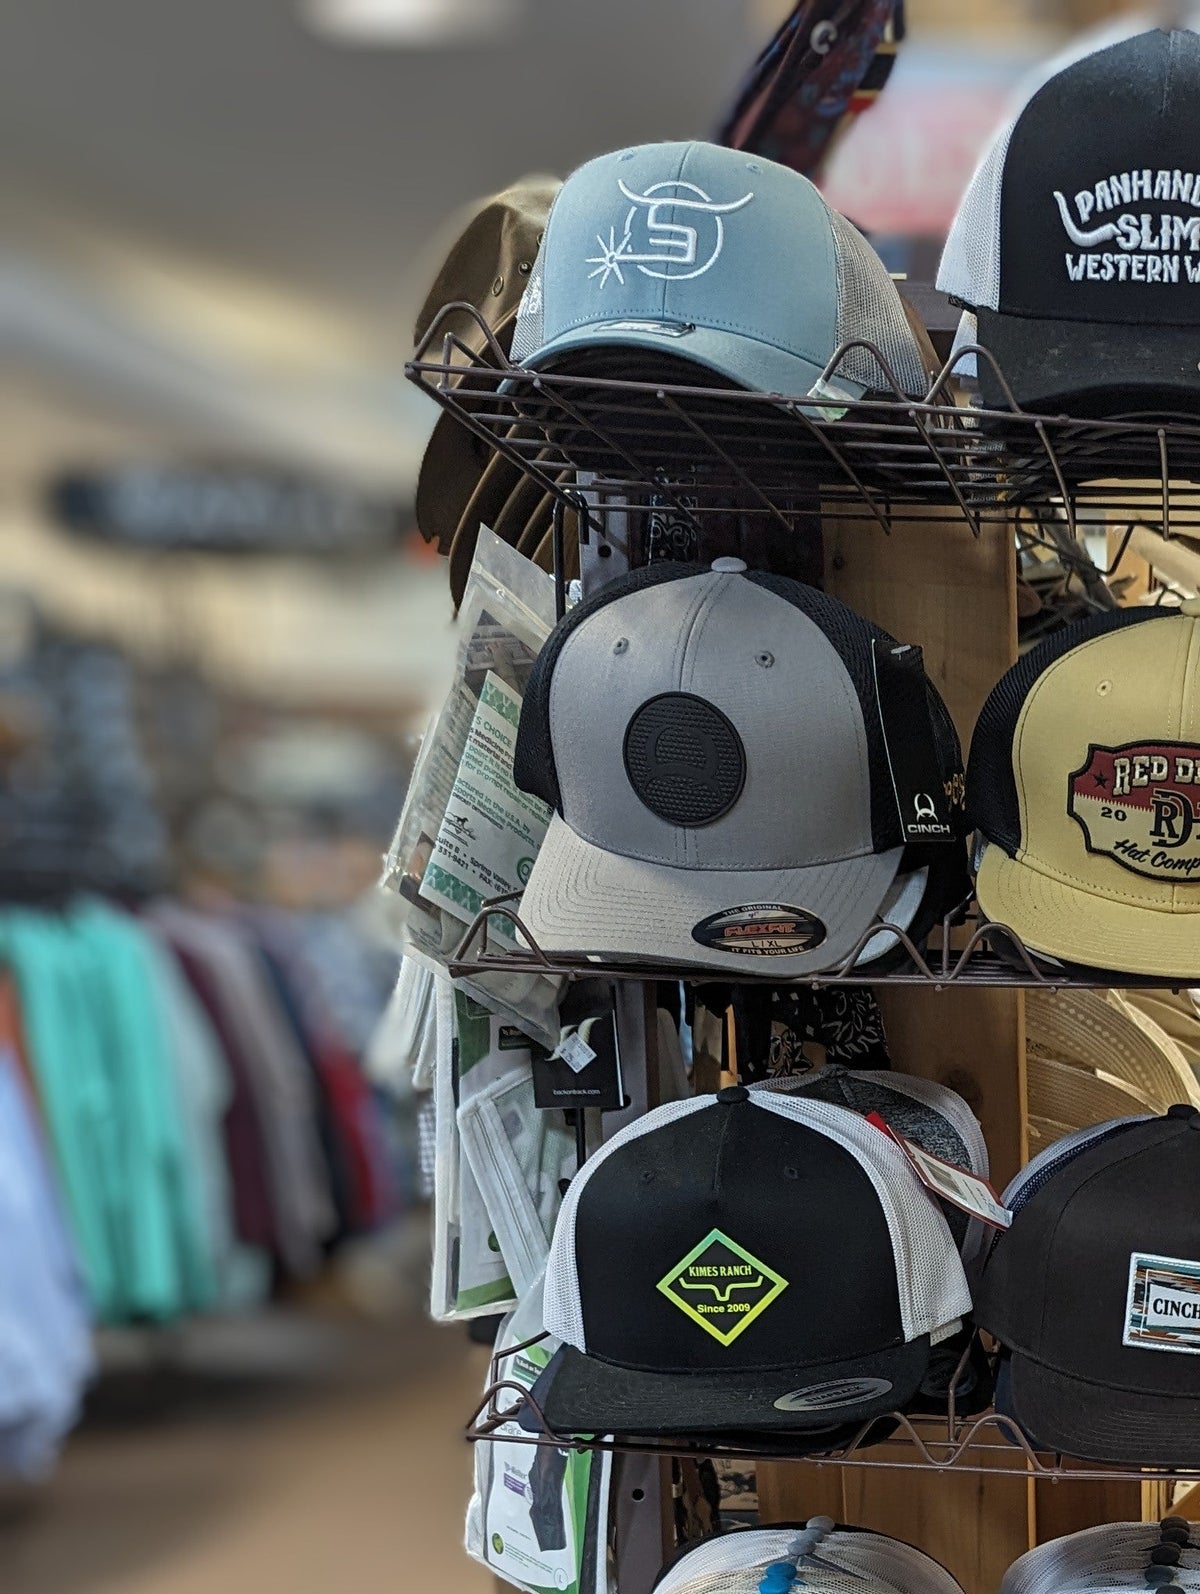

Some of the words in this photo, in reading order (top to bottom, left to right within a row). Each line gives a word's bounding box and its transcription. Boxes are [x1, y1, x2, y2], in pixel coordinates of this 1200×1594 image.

[1065, 253, 1179, 283] WESTERN
[483, 721, 514, 748] CHOICE
[475, 731, 505, 755] Medicine
[1112, 755, 1168, 796] RED
[1101, 807, 1128, 822] 20
[907, 823, 951, 834] CINCH
[1113, 839, 1151, 863] Hat
[741, 903, 783, 913] ORIGINAL
[723, 922, 797, 937] FLEXFIT
[764, 947, 787, 955] YOUR
[689, 1266, 719, 1277] KIMES
[720, 1265, 752, 1276] RANCH
[697, 1304, 725, 1313] Since
[727, 1303, 751, 1313] 2009
